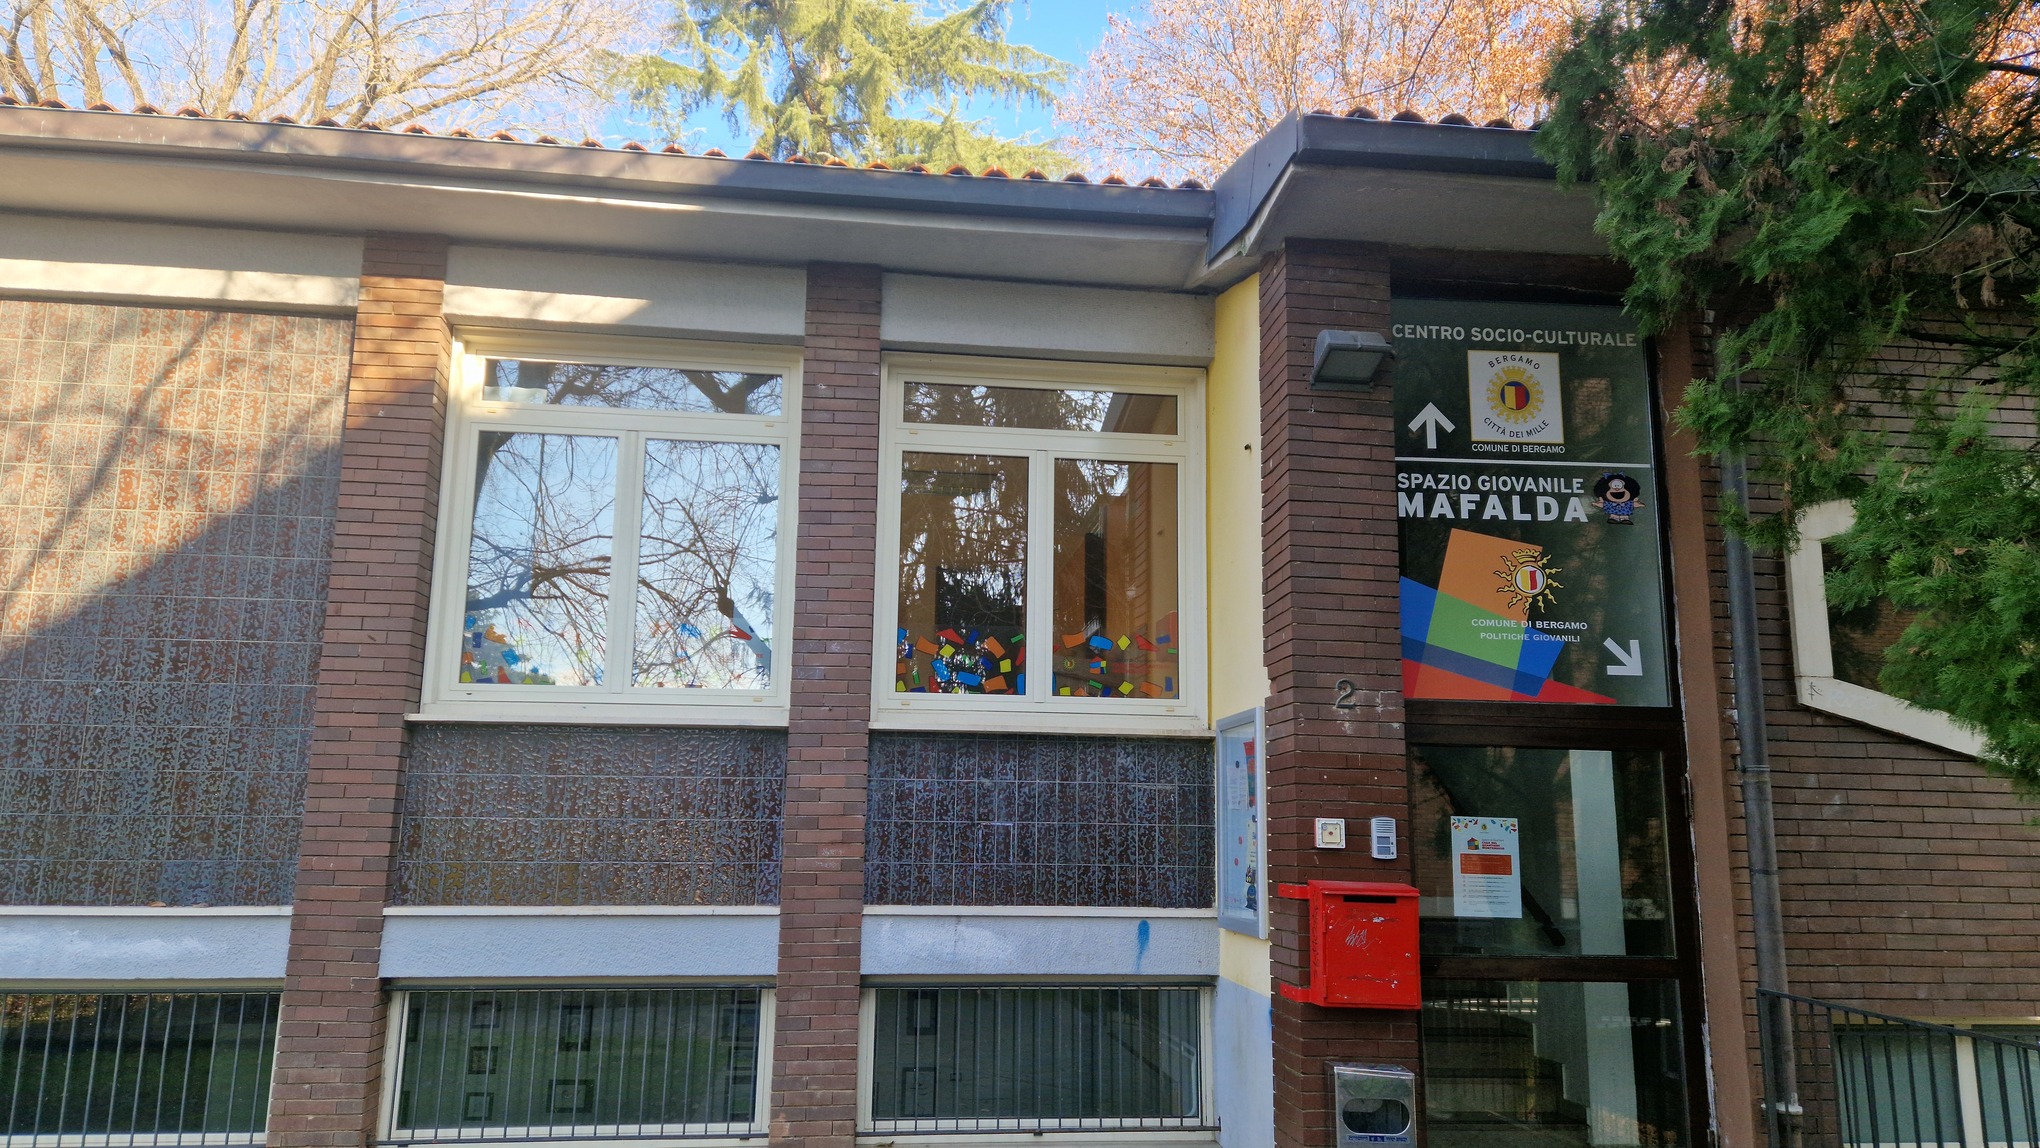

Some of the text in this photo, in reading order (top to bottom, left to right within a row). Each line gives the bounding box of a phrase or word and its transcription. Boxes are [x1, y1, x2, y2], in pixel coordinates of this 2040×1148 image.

[1392, 323, 1637, 347] CENTRO SOCIO-CULTURALE
[1488, 354, 1540, 370] BERGAMO
[1483, 417, 1550, 438] CITTÀ DEI MILLE
[1471, 443, 1566, 454] COMUNE DI BERGAMO
[1397, 473, 1585, 494] SPAZIO GIOVANILE
[1397, 492, 1589, 523] MAFALDA
[1471, 618, 1588, 630] COMUNE DI BERGAMO
[1480, 632, 1581, 642] POLITICHE GIOVANILI
[1335, 678, 1356, 709] 2
